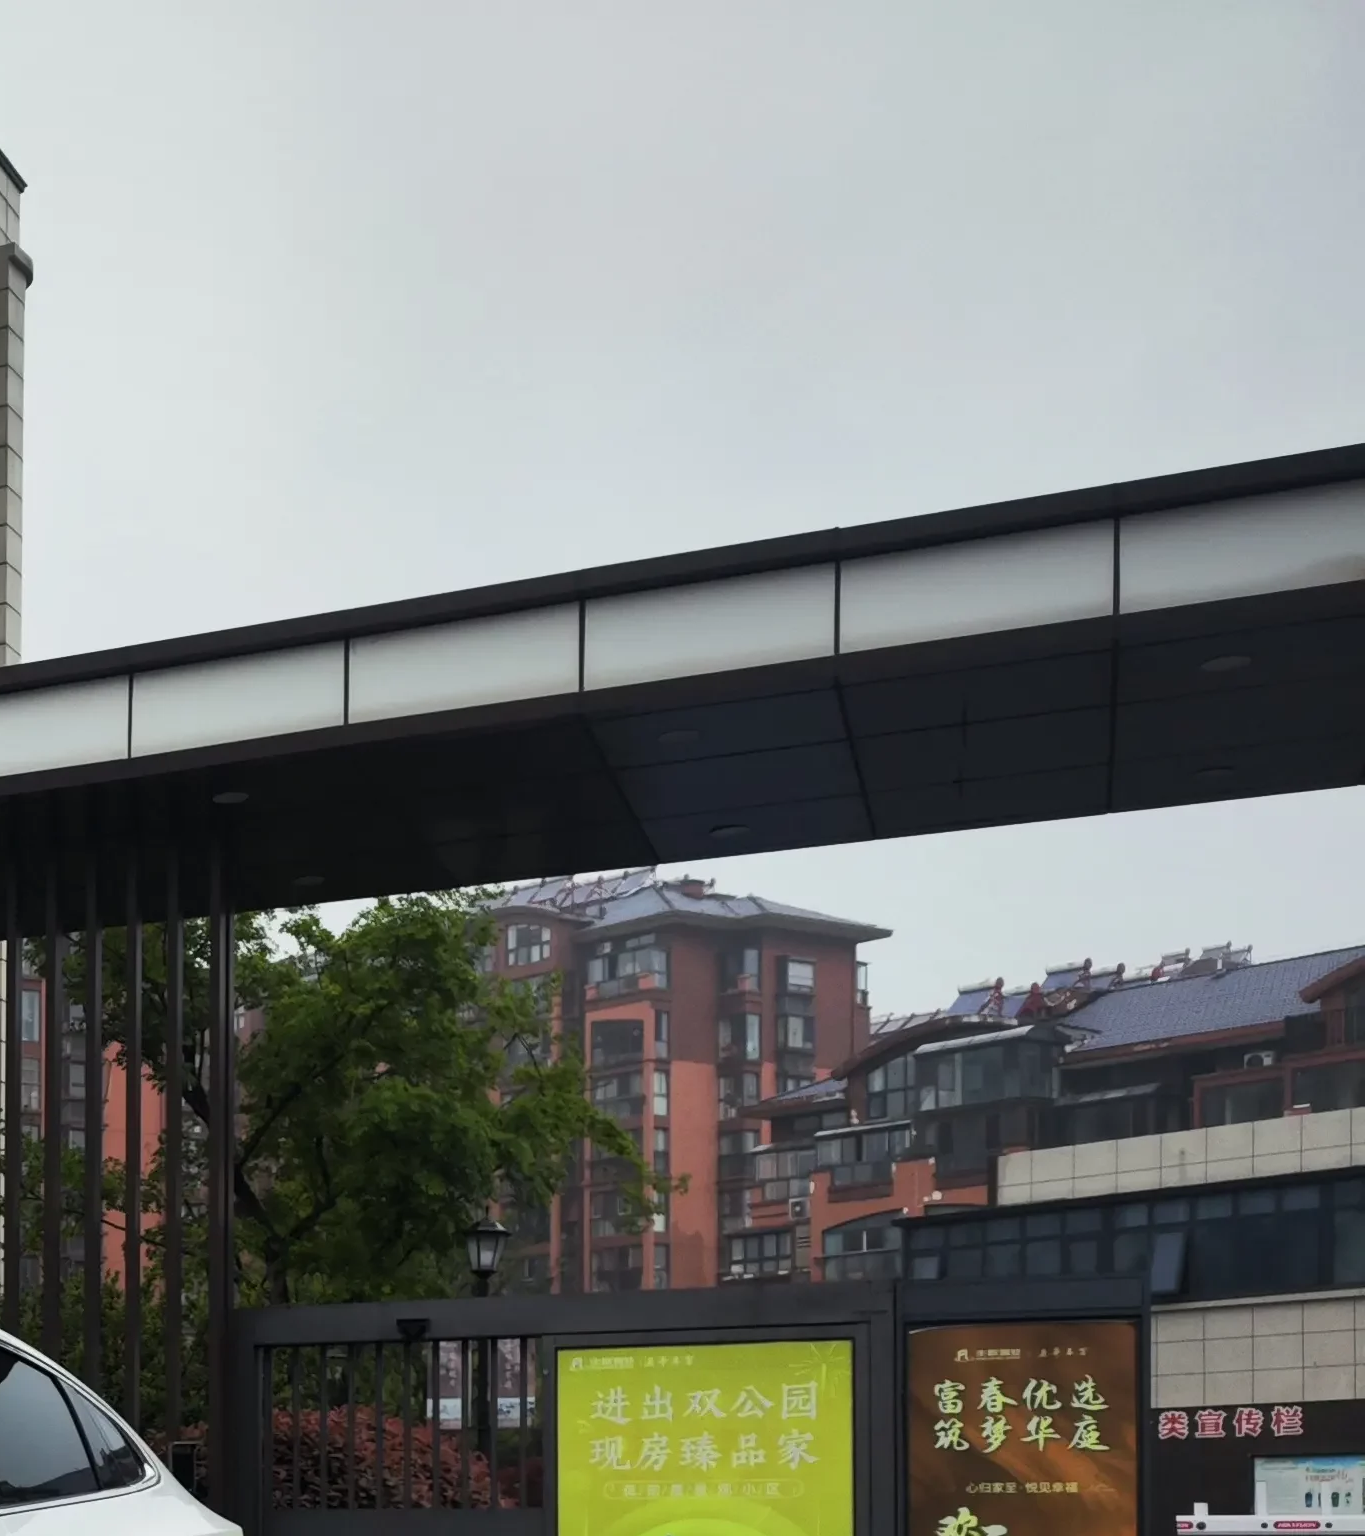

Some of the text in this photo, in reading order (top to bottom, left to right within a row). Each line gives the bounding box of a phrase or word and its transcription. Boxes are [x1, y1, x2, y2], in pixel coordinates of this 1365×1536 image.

[590, 1381, 818, 1425] 进出双公园
[934, 1374, 1110, 1414] 富春优选
[589, 1429, 820, 1472] 现房臻品家
[934, 1414, 1110, 1453] 筑梦华庭
